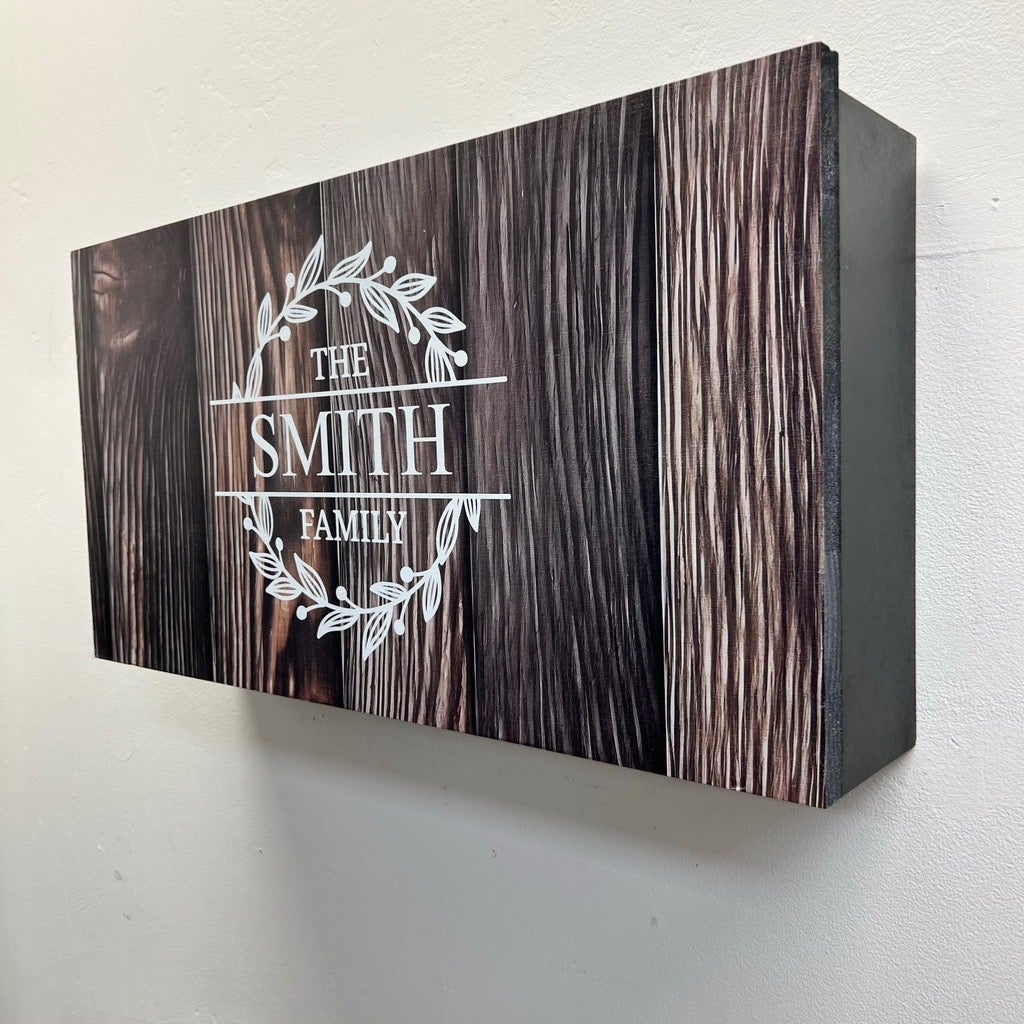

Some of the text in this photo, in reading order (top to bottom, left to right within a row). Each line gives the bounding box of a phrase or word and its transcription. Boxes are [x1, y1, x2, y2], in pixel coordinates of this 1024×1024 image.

[310, 342, 370, 380] THE
[250, 403, 453, 478] SMITH
[299, 508, 408, 544] FAMILY
